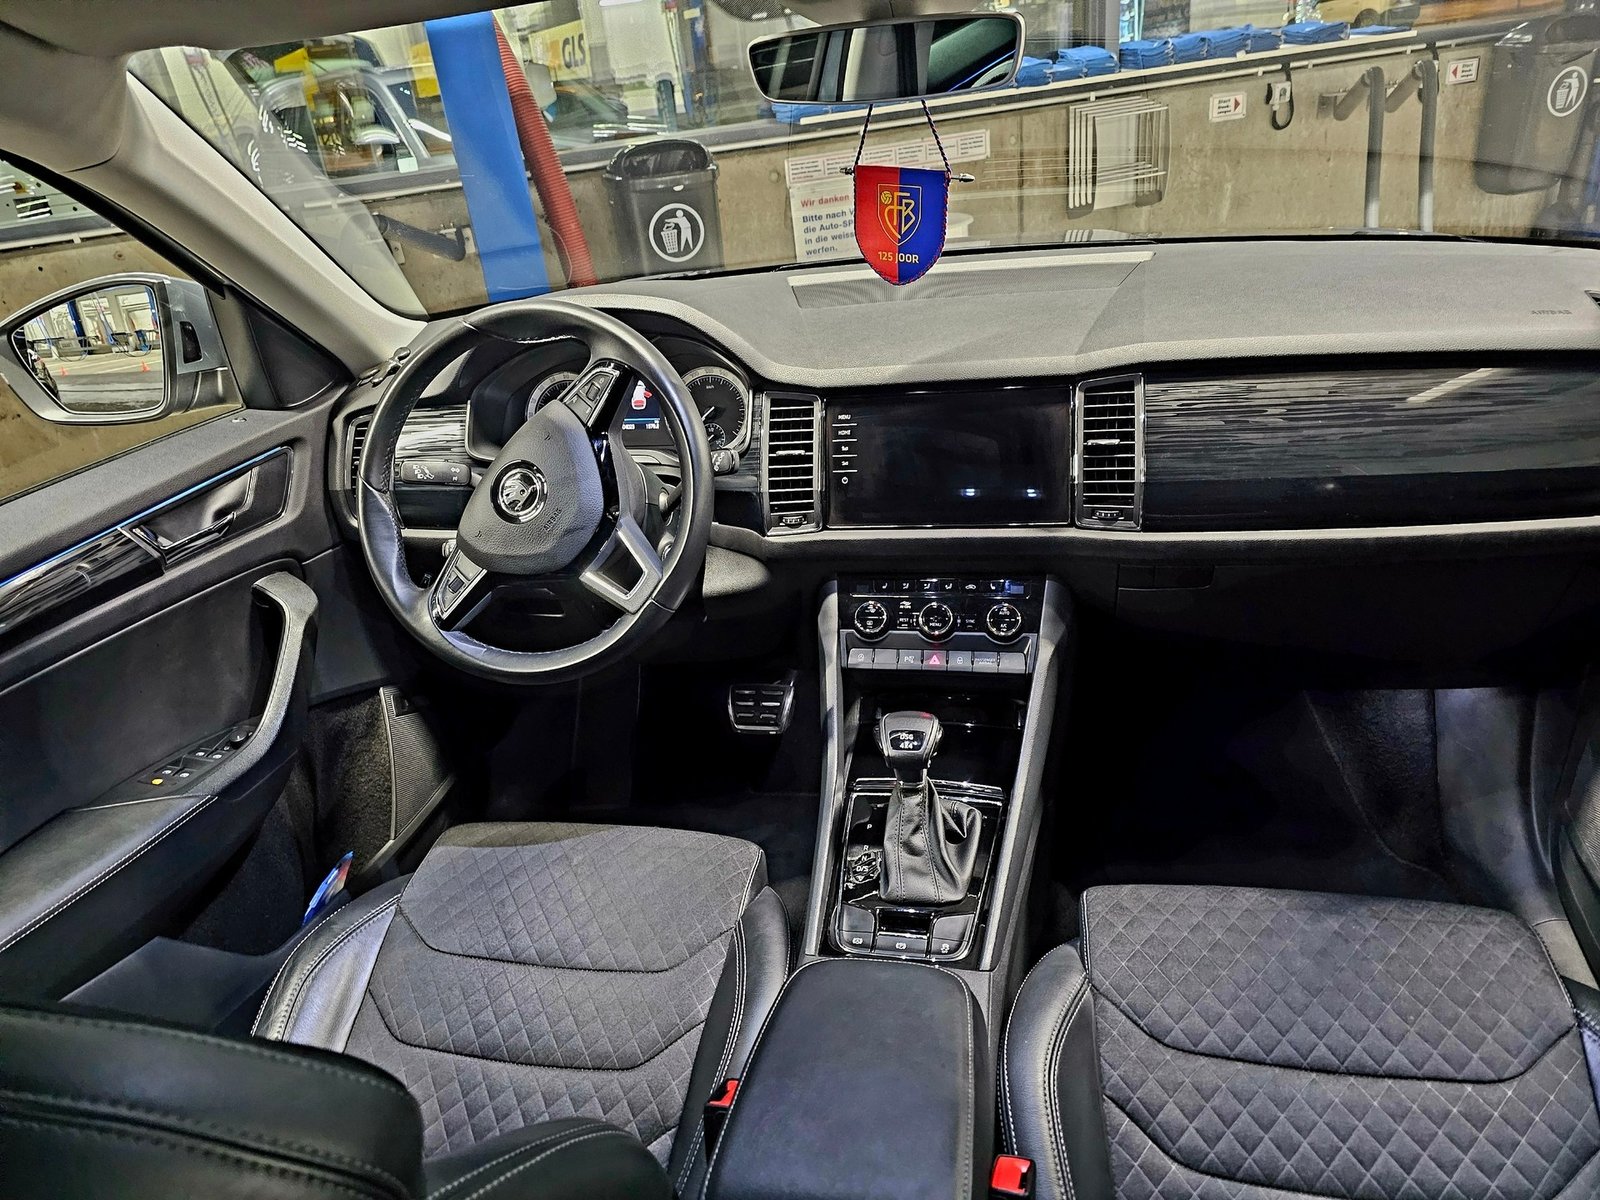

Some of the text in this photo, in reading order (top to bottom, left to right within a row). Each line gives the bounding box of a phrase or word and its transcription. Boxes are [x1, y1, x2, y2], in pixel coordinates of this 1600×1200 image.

[562, 33, 586, 69] GLS
[800, 194, 850, 208] Wir danken
[802, 213, 823, 223] Bitte
[825, 209, 847, 219] nach
[803, 225, 817, 235] die
[815, 235, 828, 243] die
[831, 231, 855, 240] weiss
[805, 245, 838, 256] werfen.
[878, 251, 919, 264] 125 JOOR
